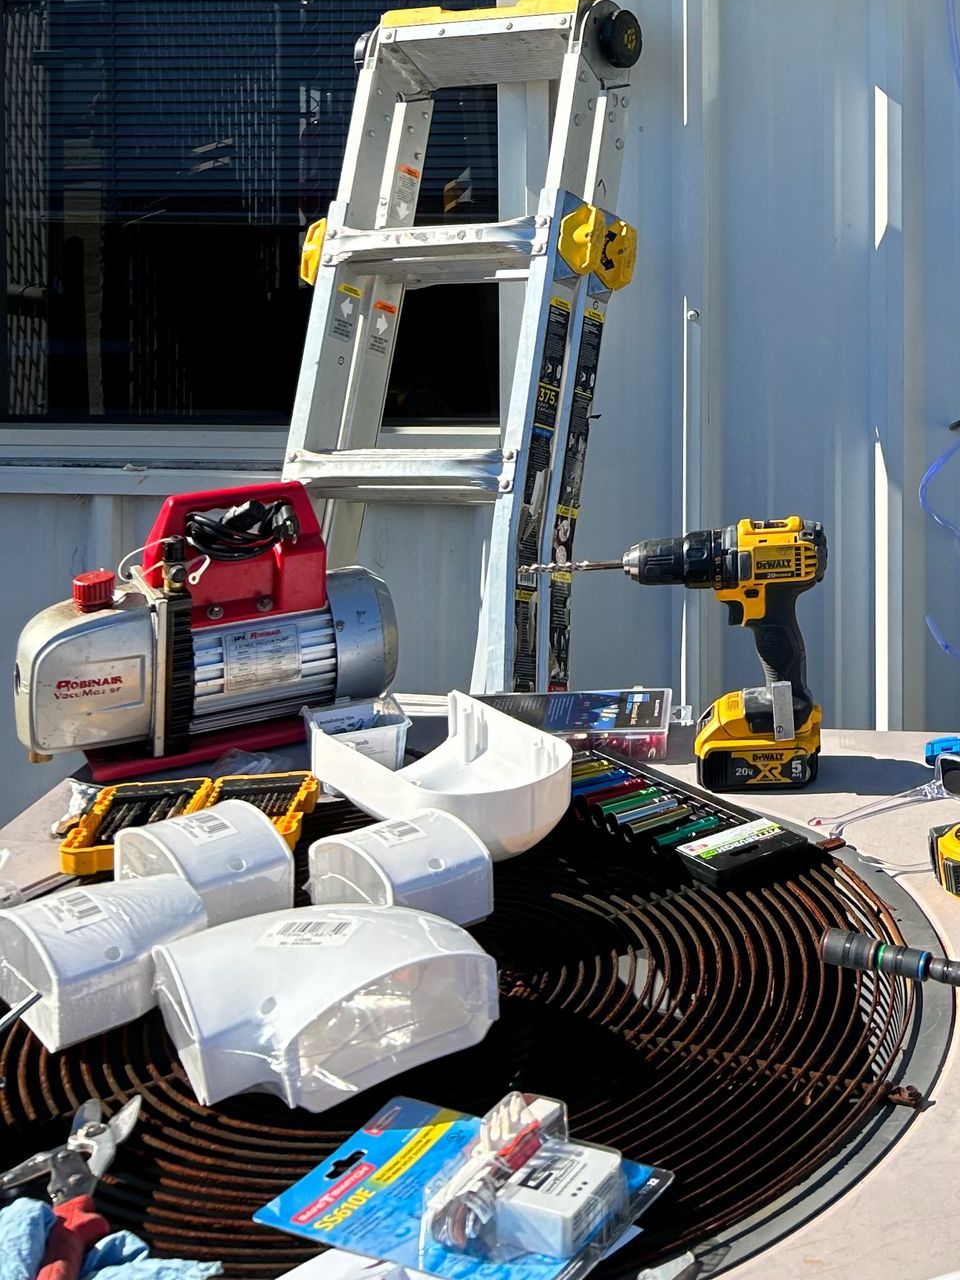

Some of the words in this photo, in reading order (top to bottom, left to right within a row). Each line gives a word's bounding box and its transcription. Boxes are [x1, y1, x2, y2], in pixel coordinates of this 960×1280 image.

[539, 388, 556, 405] 375
[56, 675, 123, 691] ROBINAIR
[791, 760, 802, 773] 5
[312, 1187, 377, 1232] SS610E
